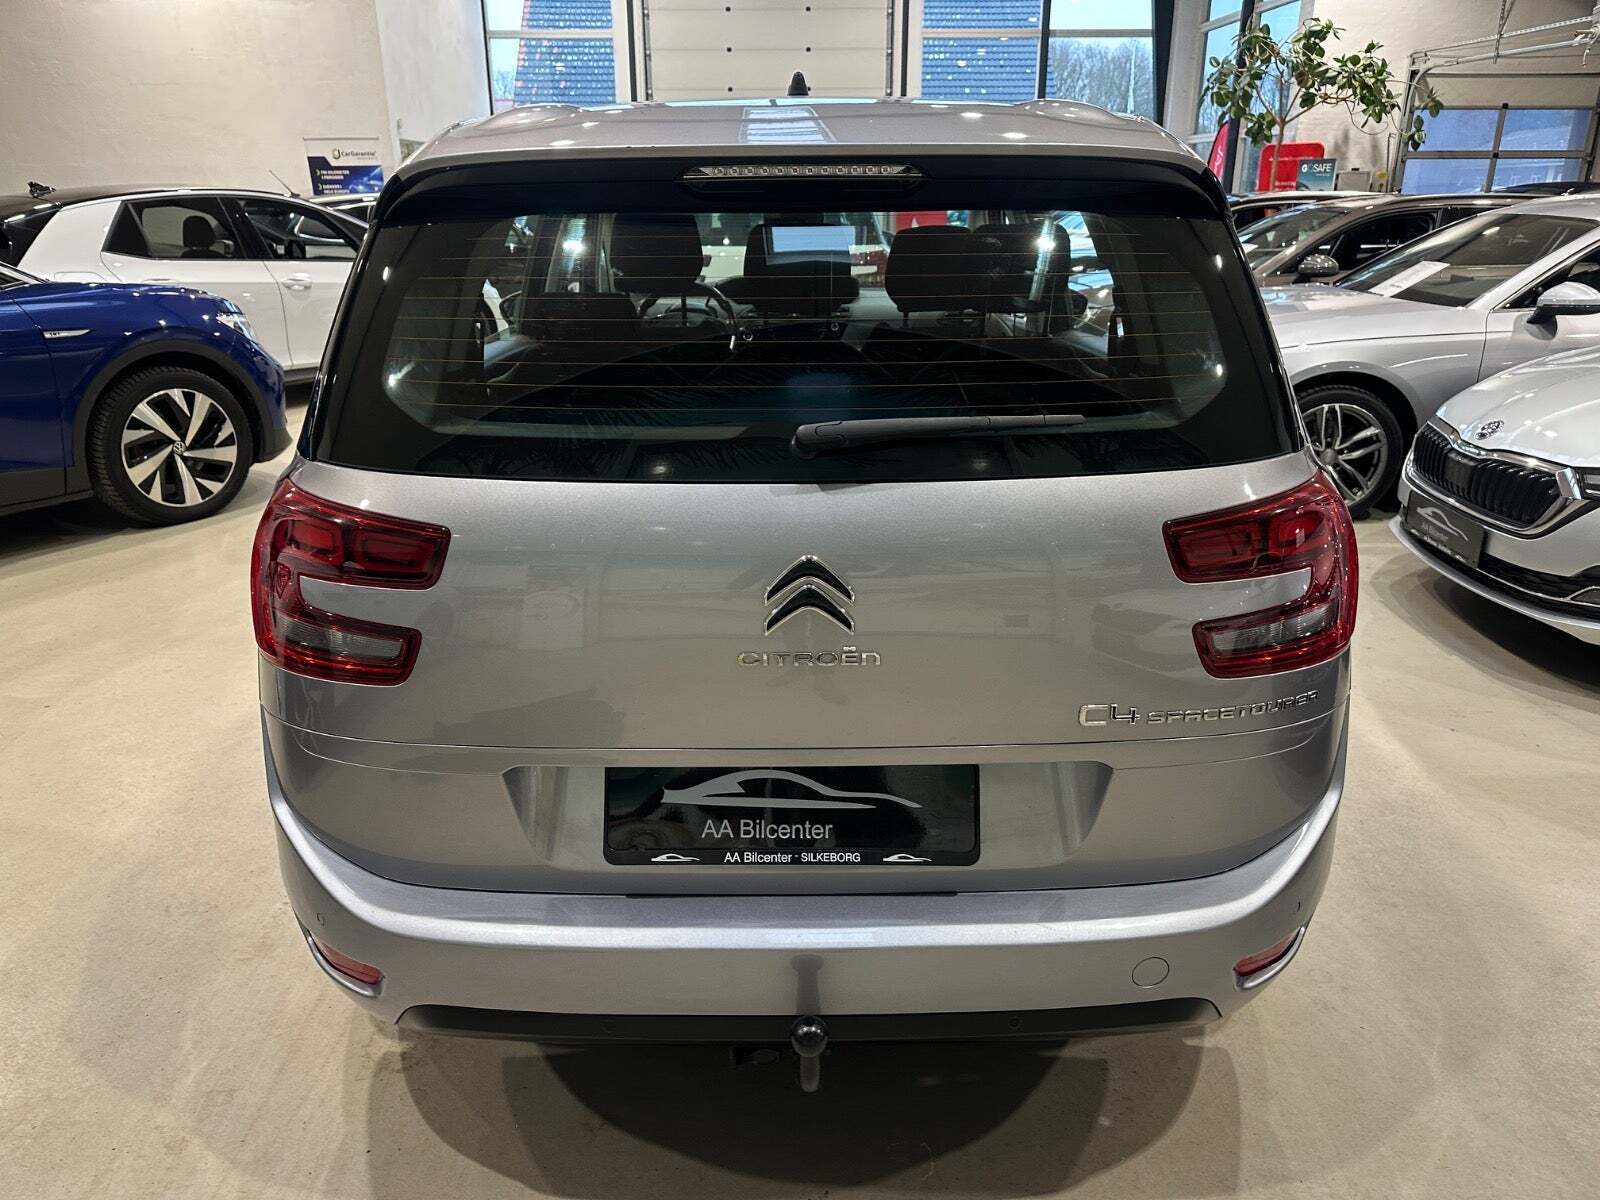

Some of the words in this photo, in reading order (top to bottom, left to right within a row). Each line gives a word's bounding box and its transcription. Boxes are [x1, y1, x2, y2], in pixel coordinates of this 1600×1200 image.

[1078, 703, 1141, 727] C4
[1146, 690, 1319, 725] SPACETOURER
[701, 820, 733, 839] AA
[740, 818, 834, 839] Bilcenter
[724, 852, 741, 863] AA
[743, 851, 792, 863] Bilcenter
[800, 851, 861, 863] SILKEBORG
